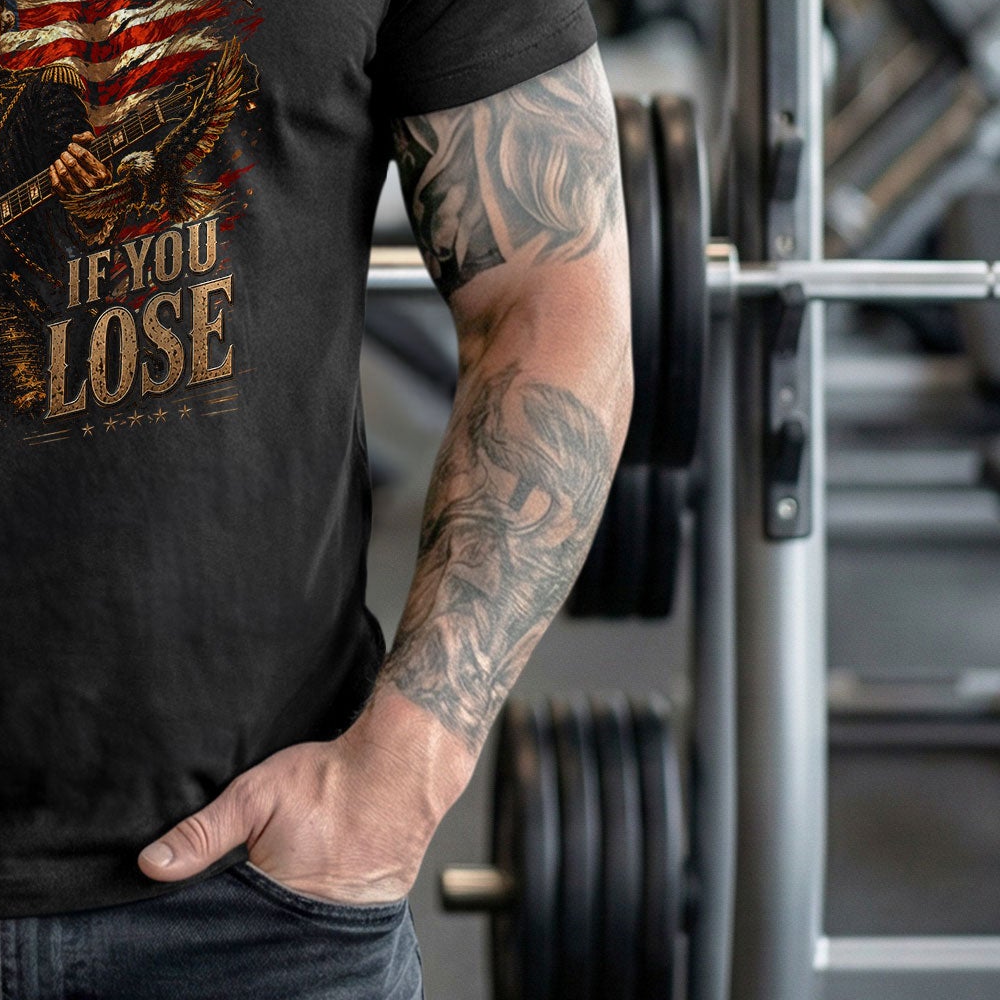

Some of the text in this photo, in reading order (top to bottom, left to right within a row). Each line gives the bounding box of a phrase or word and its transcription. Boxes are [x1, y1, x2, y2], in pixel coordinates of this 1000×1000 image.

[66, 217, 220, 309] IF YOU
[44, 273, 235, 420] LOSE
